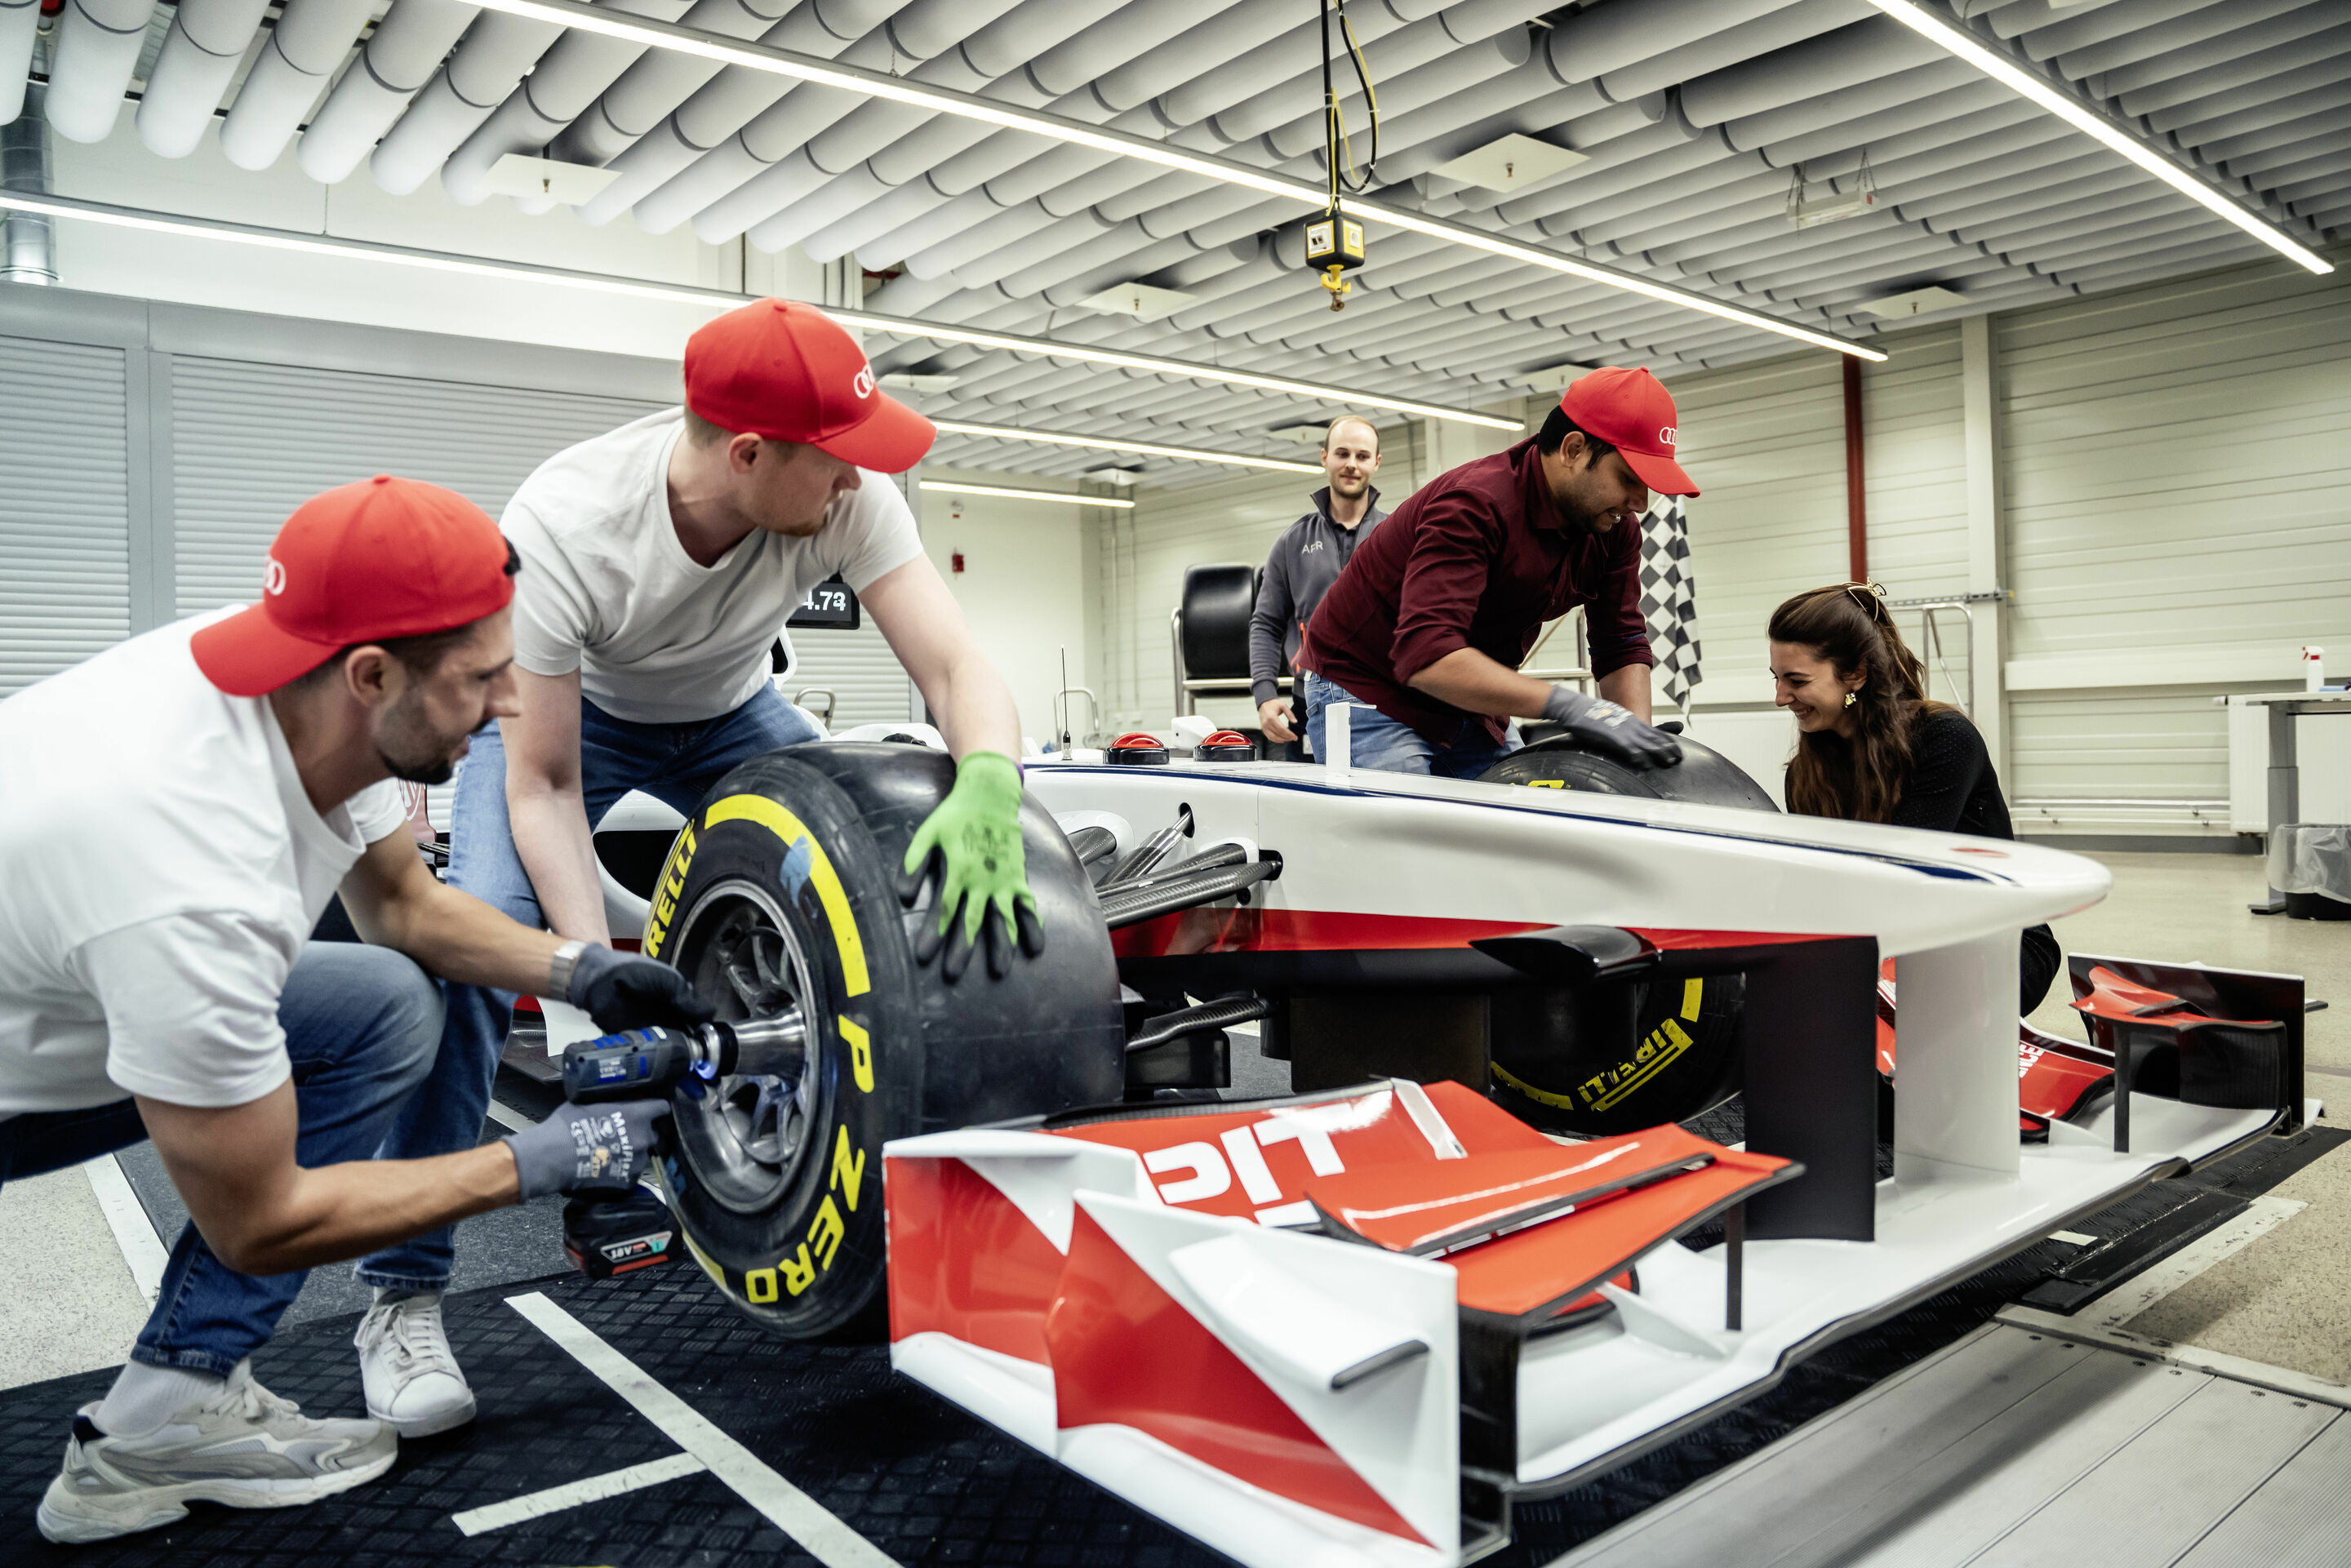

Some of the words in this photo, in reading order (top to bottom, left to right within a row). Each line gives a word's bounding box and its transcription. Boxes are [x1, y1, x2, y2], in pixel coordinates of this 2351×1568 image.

[1301, 540, 1323, 554] AFR
[838, 1014, 874, 1093] P
[1143, 1102, 1353, 1205] PIT
[745, 1124, 865, 1304] ZERO
